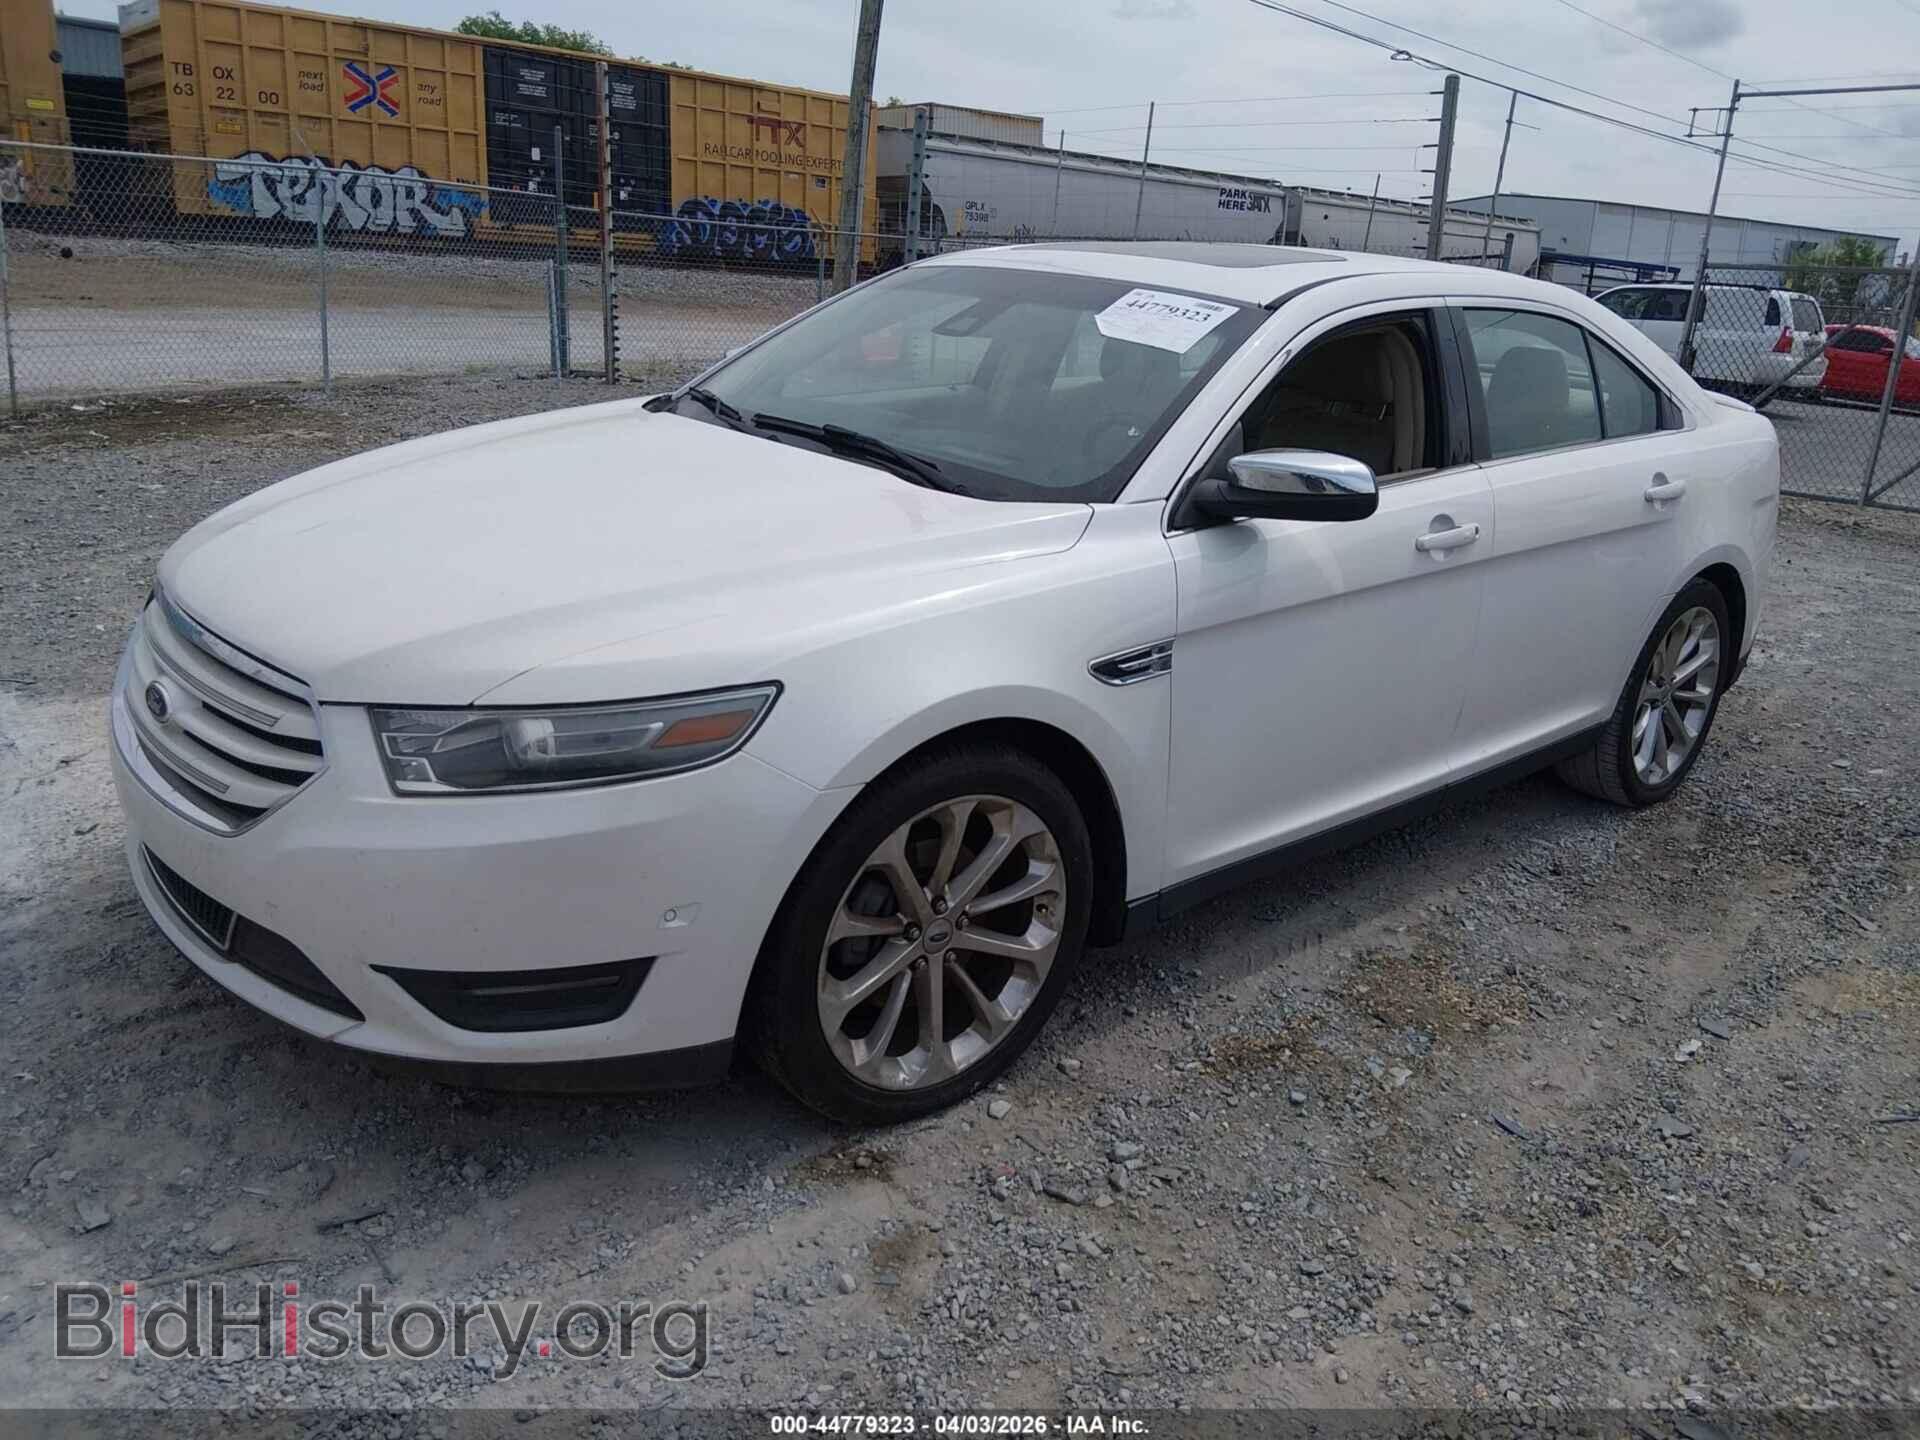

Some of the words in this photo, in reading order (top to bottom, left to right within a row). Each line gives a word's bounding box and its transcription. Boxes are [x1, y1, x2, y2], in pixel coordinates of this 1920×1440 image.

[173, 62, 193, 77] TB
[212, 66, 235, 81] OX
[172, 82, 195, 97] 63
[216, 86, 235, 101] 22
[257, 90, 280, 105] 00
[417, 83, 437, 95] any
[417, 96, 442, 107] road
[805, 155, 848, 171] EXPERT
[1219, 188, 1247, 200] PARK
[1218, 199, 1246, 211] HERE
